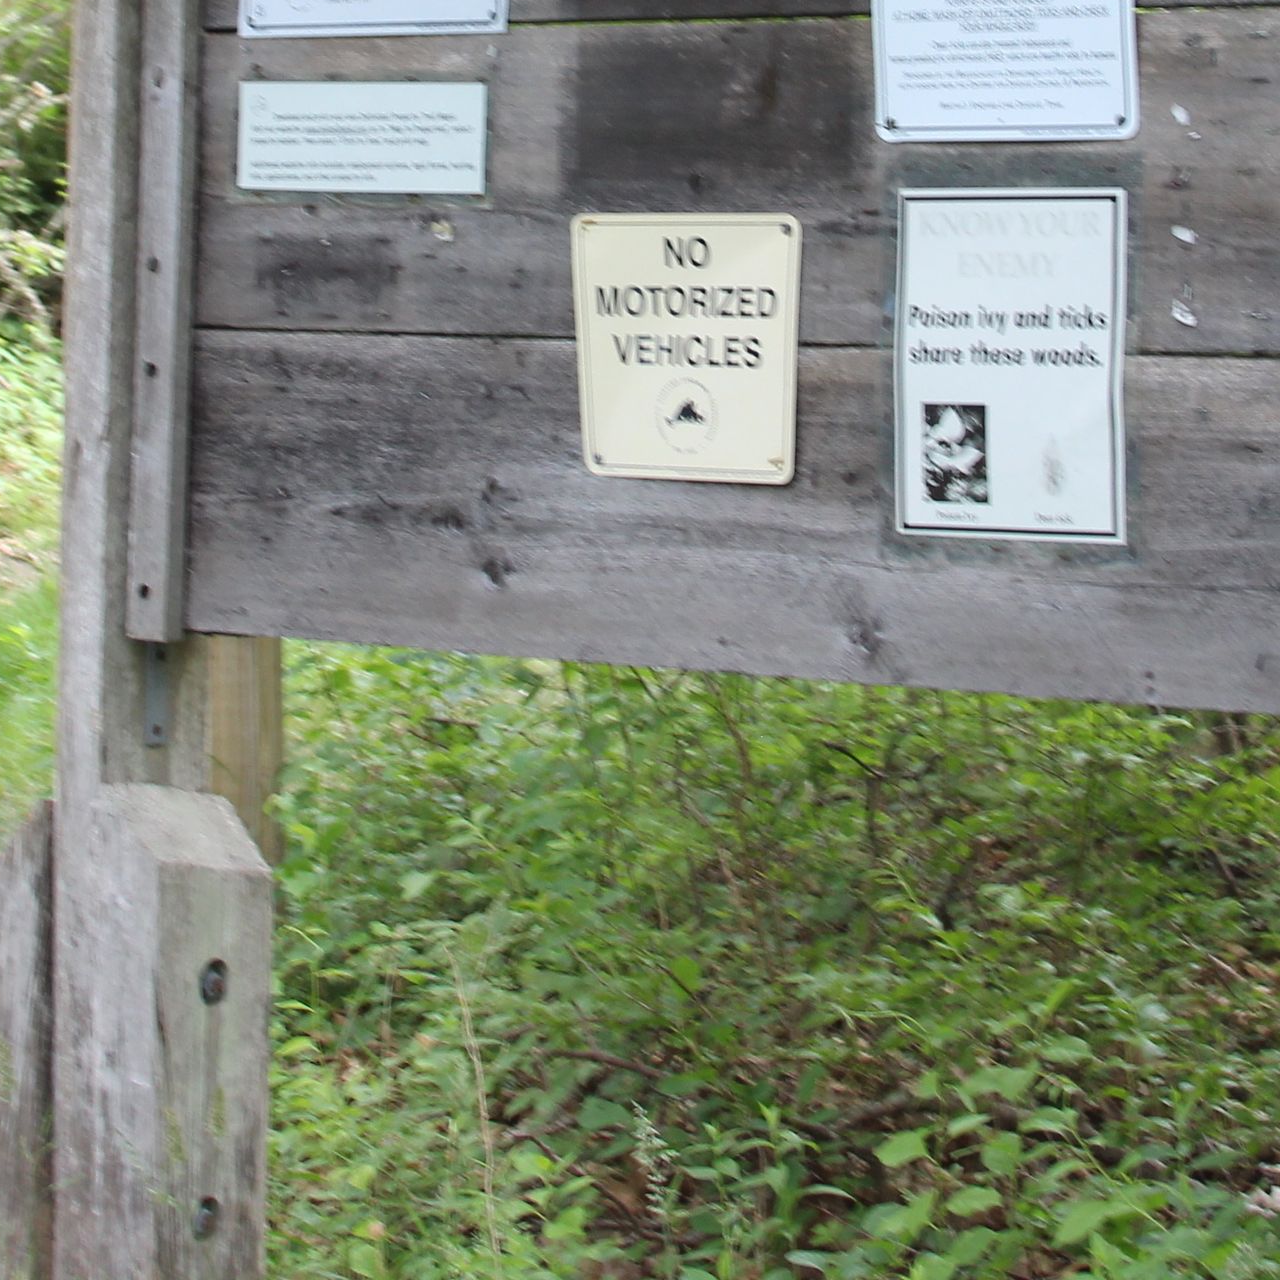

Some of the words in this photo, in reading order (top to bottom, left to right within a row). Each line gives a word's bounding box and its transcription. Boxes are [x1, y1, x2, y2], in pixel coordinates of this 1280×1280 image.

[663, 236, 711, 268] NO
[596, 285, 778, 318] MOTORIZED
[910, 305, 971, 328] Poison
[978, 305, 1006, 334] ivy
[1014, 304, 1051, 328] and
[1057, 304, 1107, 330] ticks
[612, 333, 762, 368] VEHICLES
[909, 340, 963, 365] share
[970, 339, 1024, 365] these
